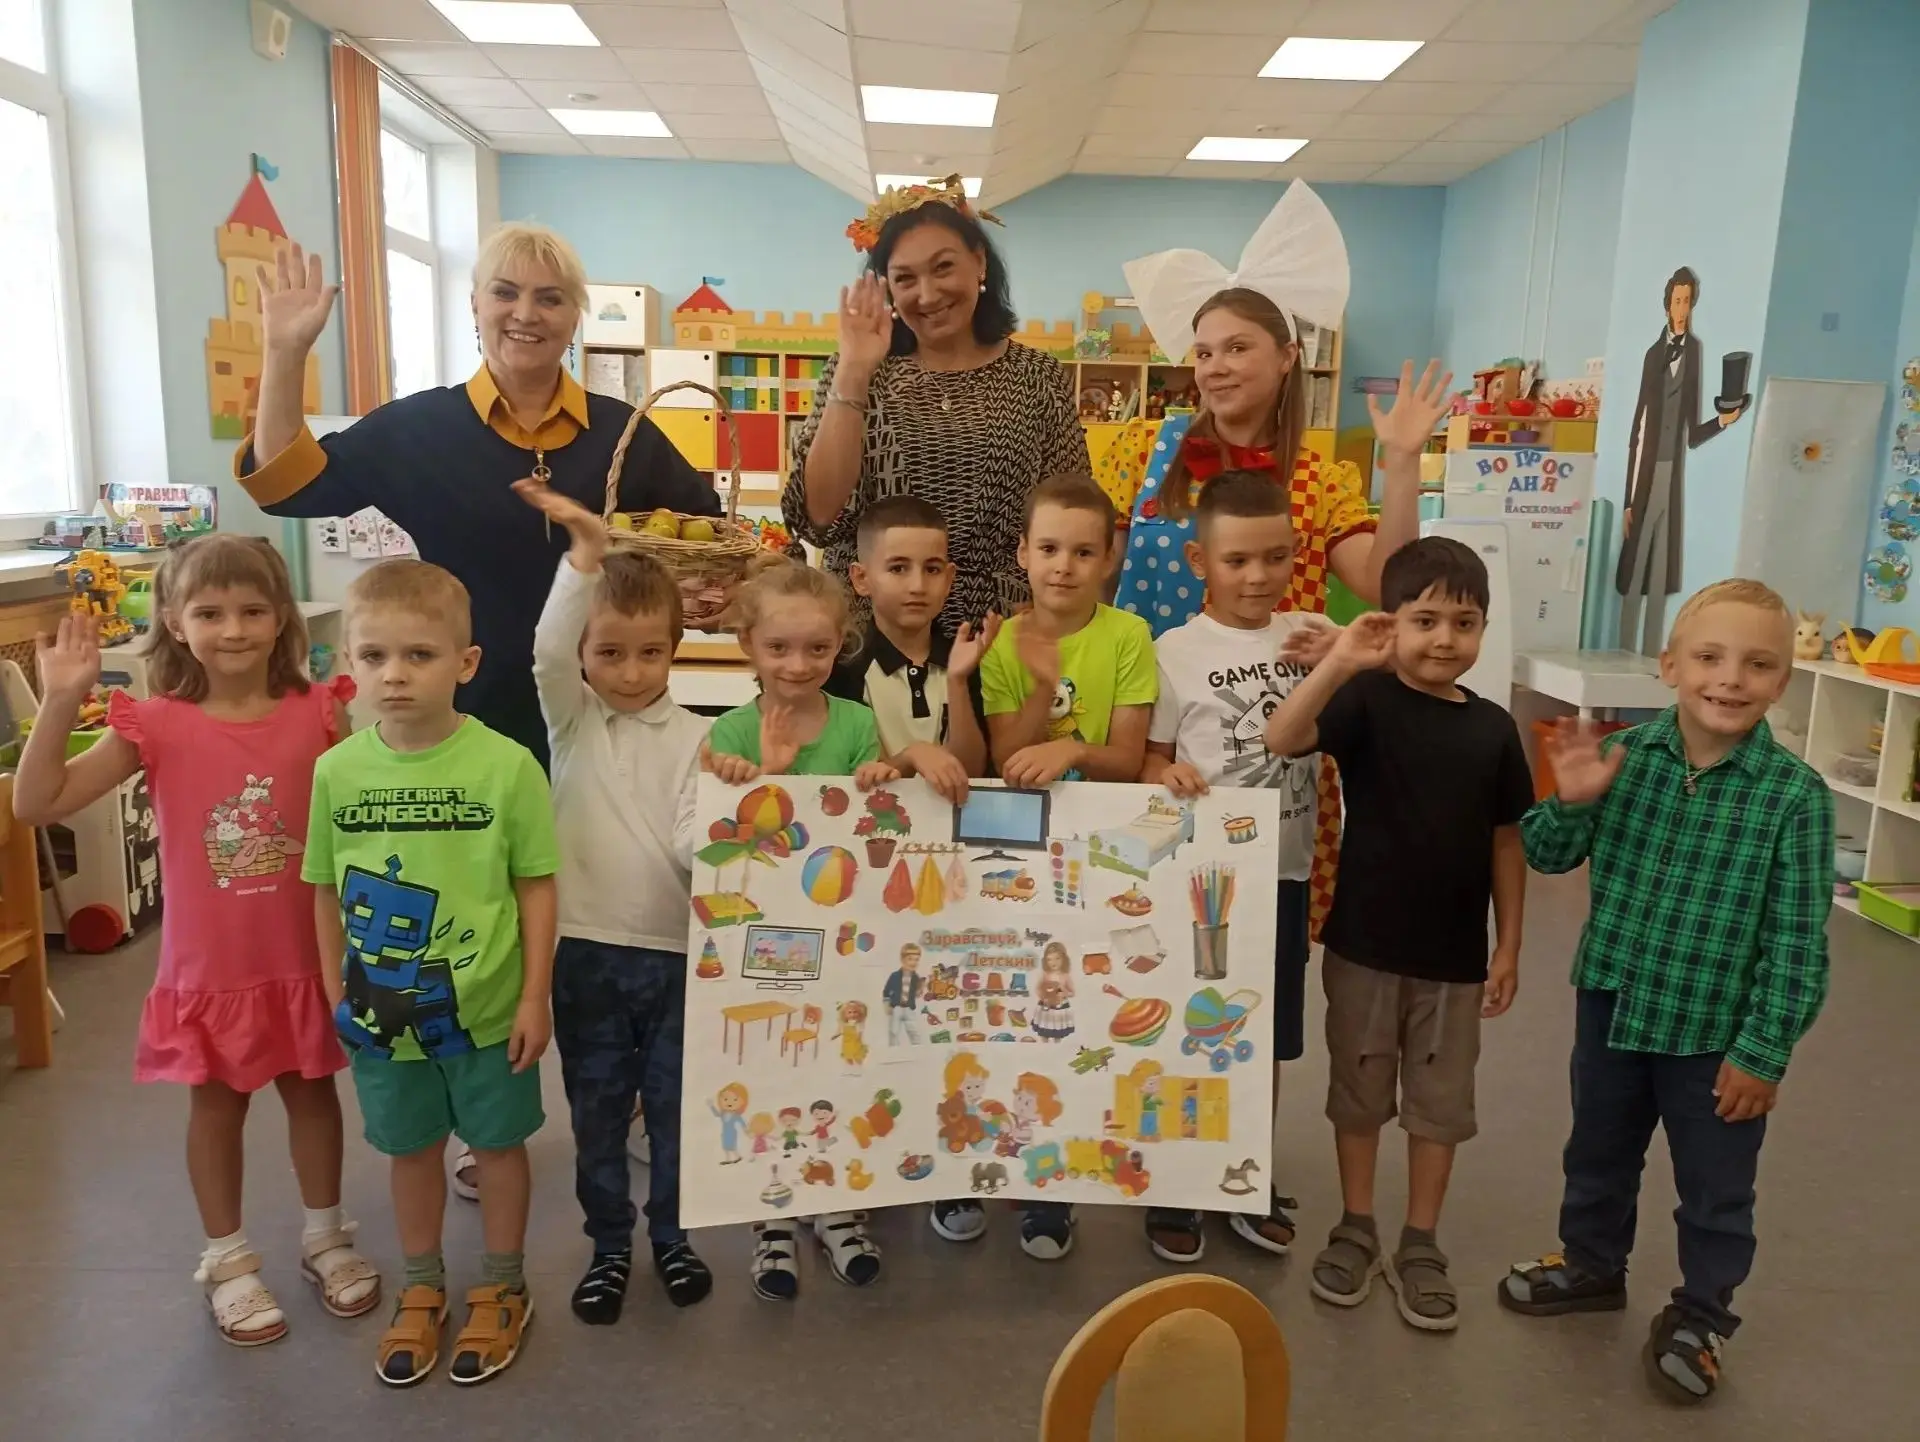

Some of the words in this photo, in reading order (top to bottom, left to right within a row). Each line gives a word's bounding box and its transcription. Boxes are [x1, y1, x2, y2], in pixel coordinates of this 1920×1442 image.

[1476, 449, 1574, 478] ВОПРОС
[1508, 476, 1558, 492] ДНЯ
[1208, 662, 1271, 688] GAME
[360, 788, 465, 804] MINECRAFT
[342, 803, 486, 827] DUNGEONS
